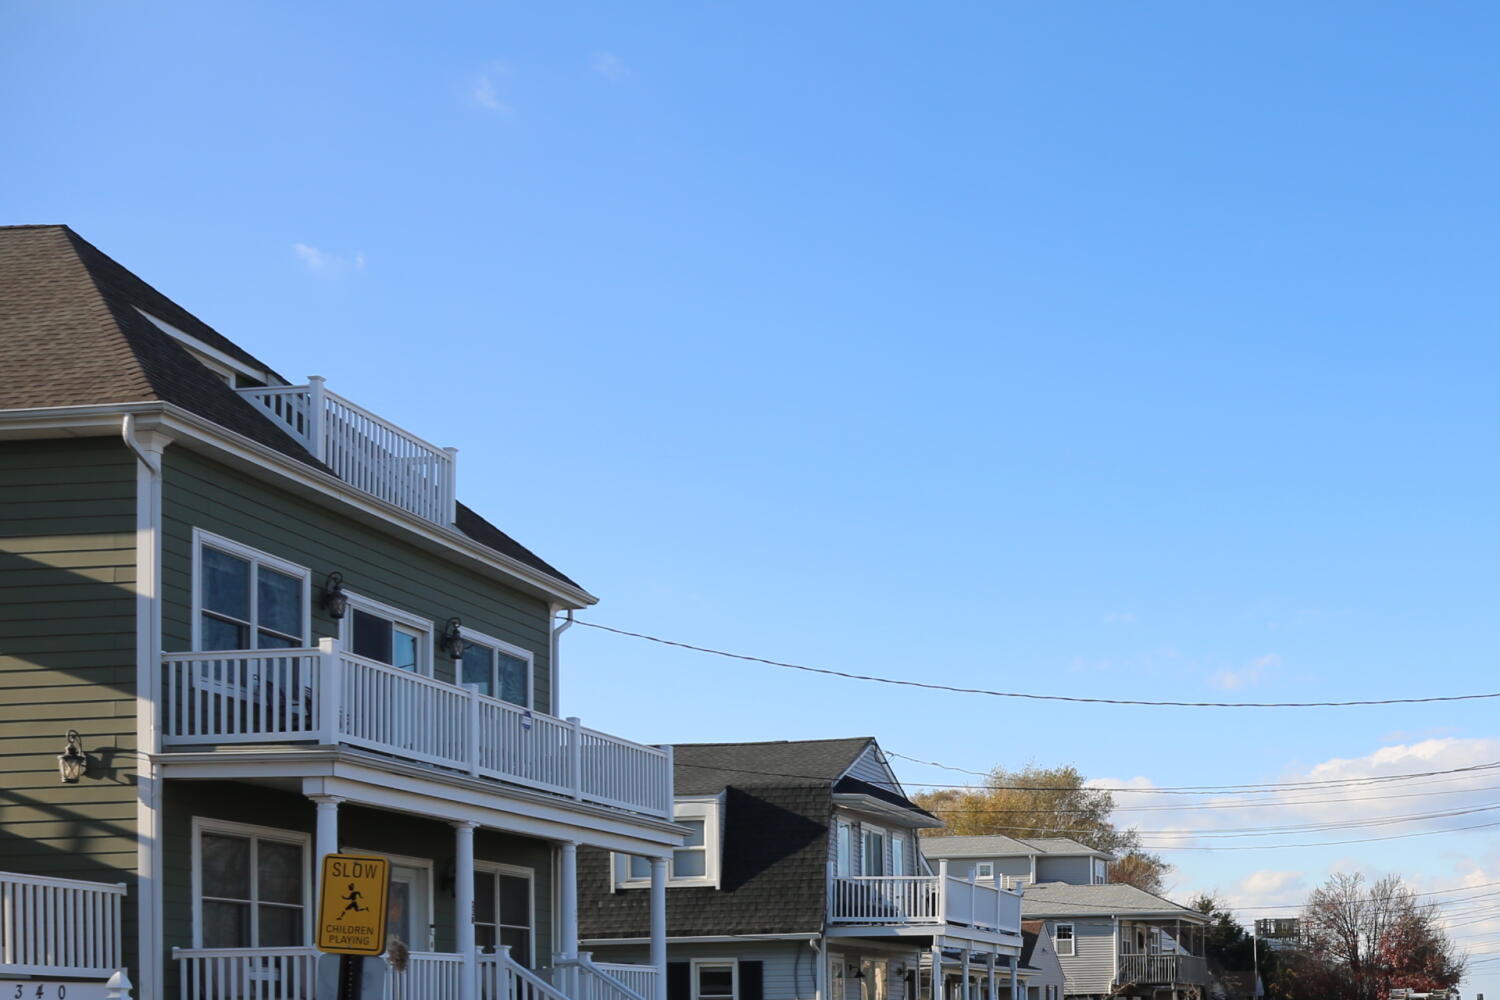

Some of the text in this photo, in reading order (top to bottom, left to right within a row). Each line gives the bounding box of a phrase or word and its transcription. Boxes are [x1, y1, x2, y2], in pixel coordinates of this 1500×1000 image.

[332, 862, 378, 879] SLOW
[326, 924, 374, 935] CHILDREN
[328, 935, 370, 945] PLAYING
